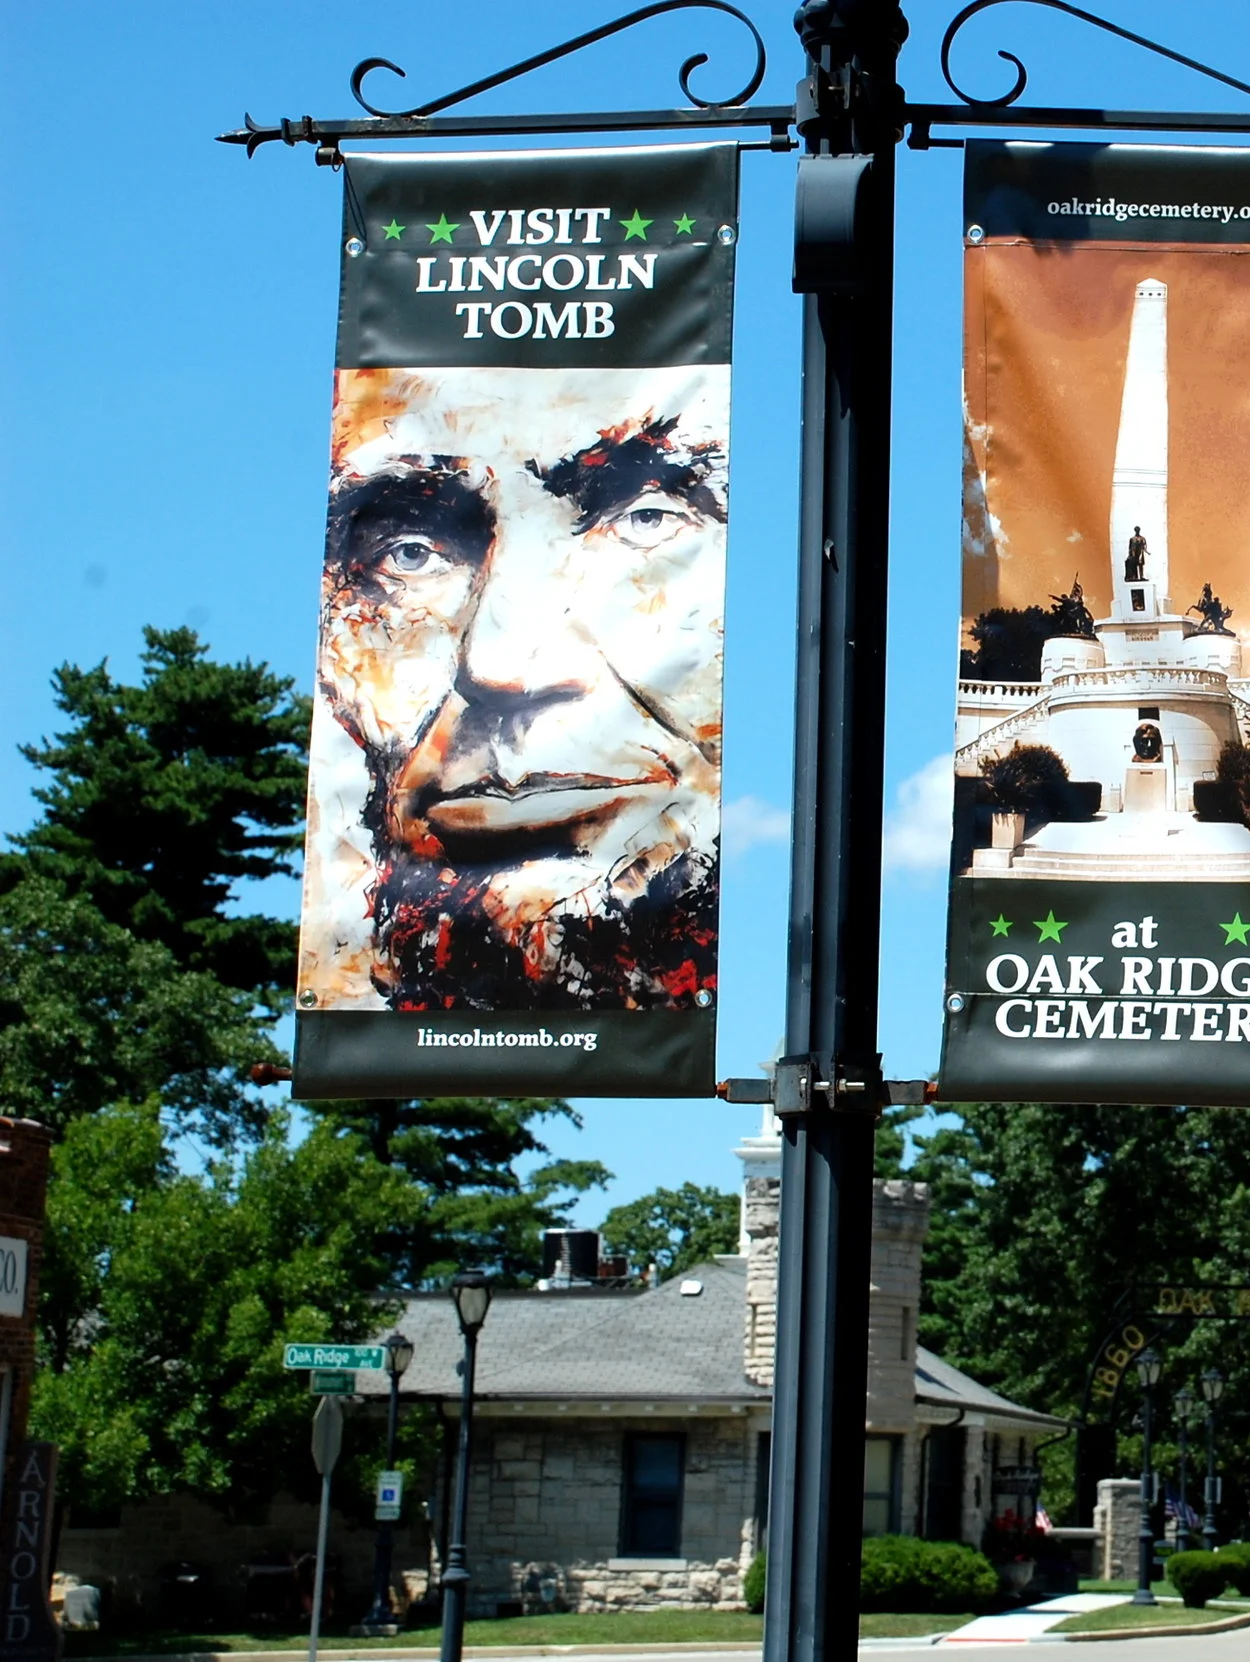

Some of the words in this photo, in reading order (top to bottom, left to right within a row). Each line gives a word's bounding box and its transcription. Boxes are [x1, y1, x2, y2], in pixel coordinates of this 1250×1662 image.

[469, 208, 610, 246] VISIT
[415, 253, 658, 292] LINCOLN
[455, 301, 616, 339] TOMB
[1111, 915, 1159, 949] at
[985, 953, 1104, 995] OAK
[417, 1028, 597, 1051] lincolntomb.org
[1158, 1287, 1216, 1316] OAK
[287, 1347, 312, 1365] Oak
[314, 1348, 350, 1368] Ridge
[1091, 1324, 1145, 1399] 1860
[6, 1451, 46, 1643] ARNOLD
